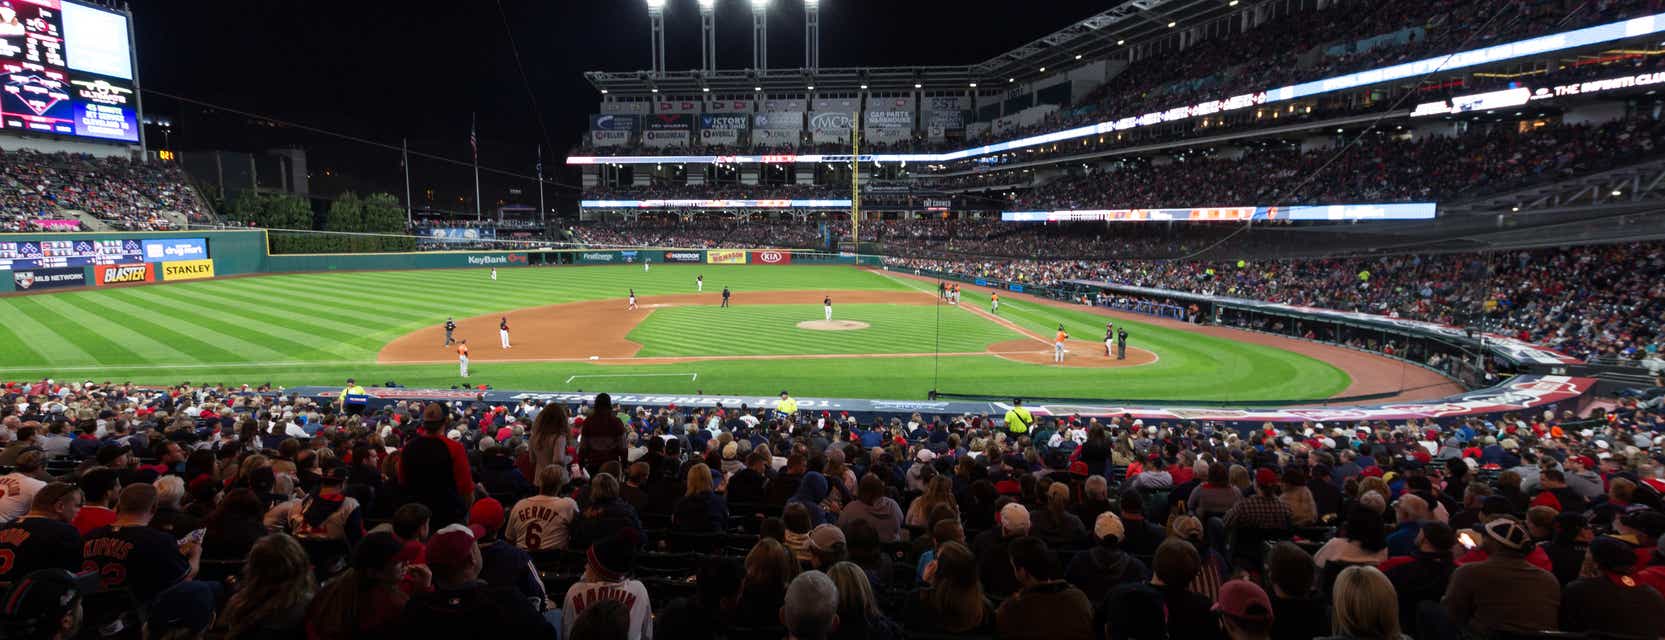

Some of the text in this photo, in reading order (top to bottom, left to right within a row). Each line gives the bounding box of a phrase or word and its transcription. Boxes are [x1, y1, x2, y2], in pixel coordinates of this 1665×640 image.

[1554, 84, 1580, 96] THE
[1635, 71, 1665, 86] CLU
[468, 255, 507, 265] KeyBank
[764, 253, 778, 261] KIA
[104, 267, 146, 282] BLASTER
[166, 263, 210, 276] STANLEY
[525, 521, 543, 549] 6
